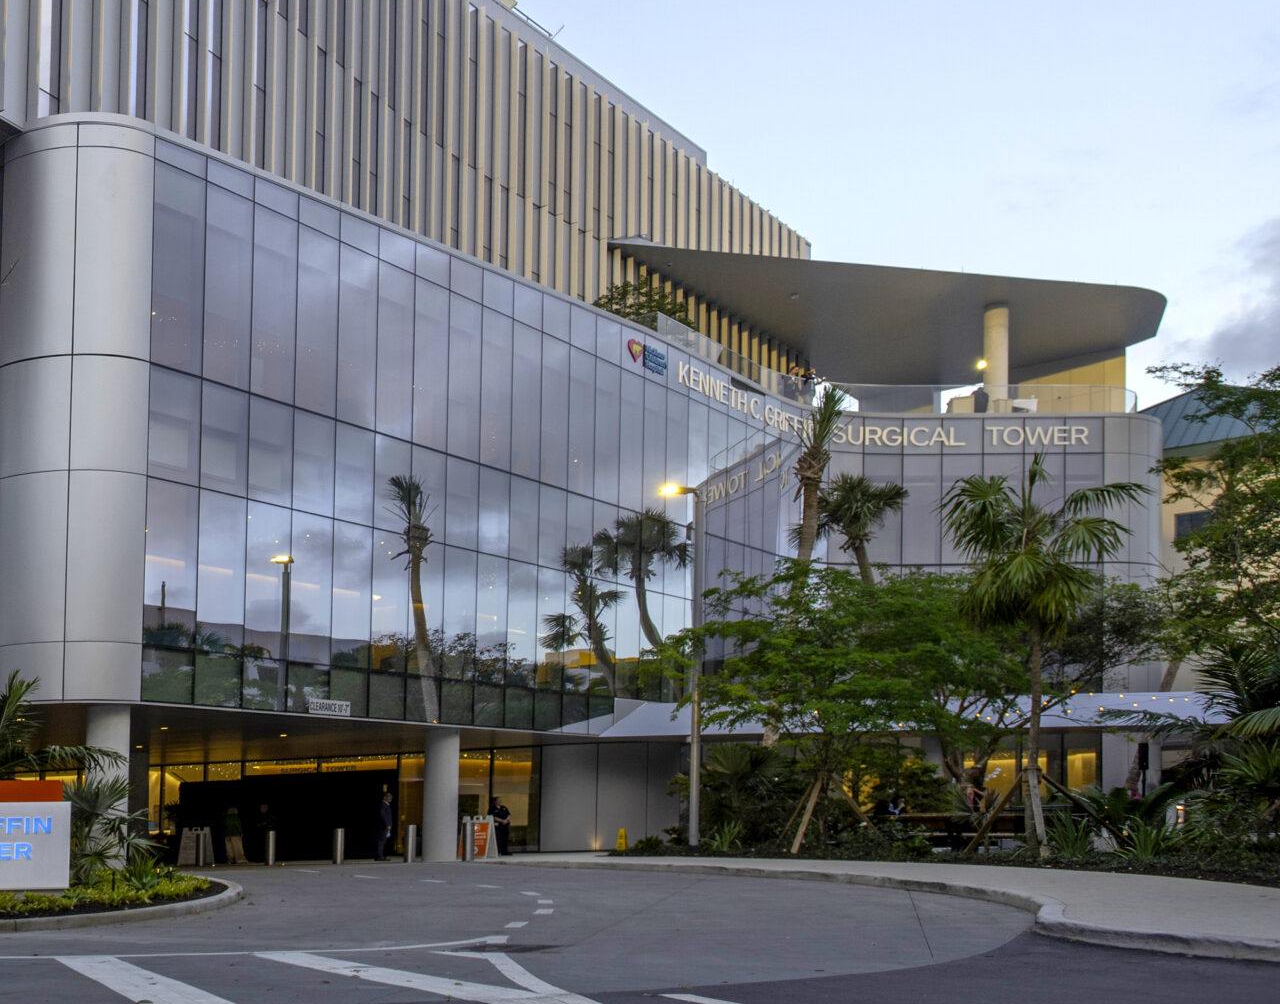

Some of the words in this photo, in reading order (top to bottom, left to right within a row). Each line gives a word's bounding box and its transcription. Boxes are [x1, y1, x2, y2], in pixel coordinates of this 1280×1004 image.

[678, 361, 748, 414] KENNETH
[750, 397, 763, 421] C.
[832, 423, 966, 447] SURGICAL
[986, 425, 1090, 446] TOWER
